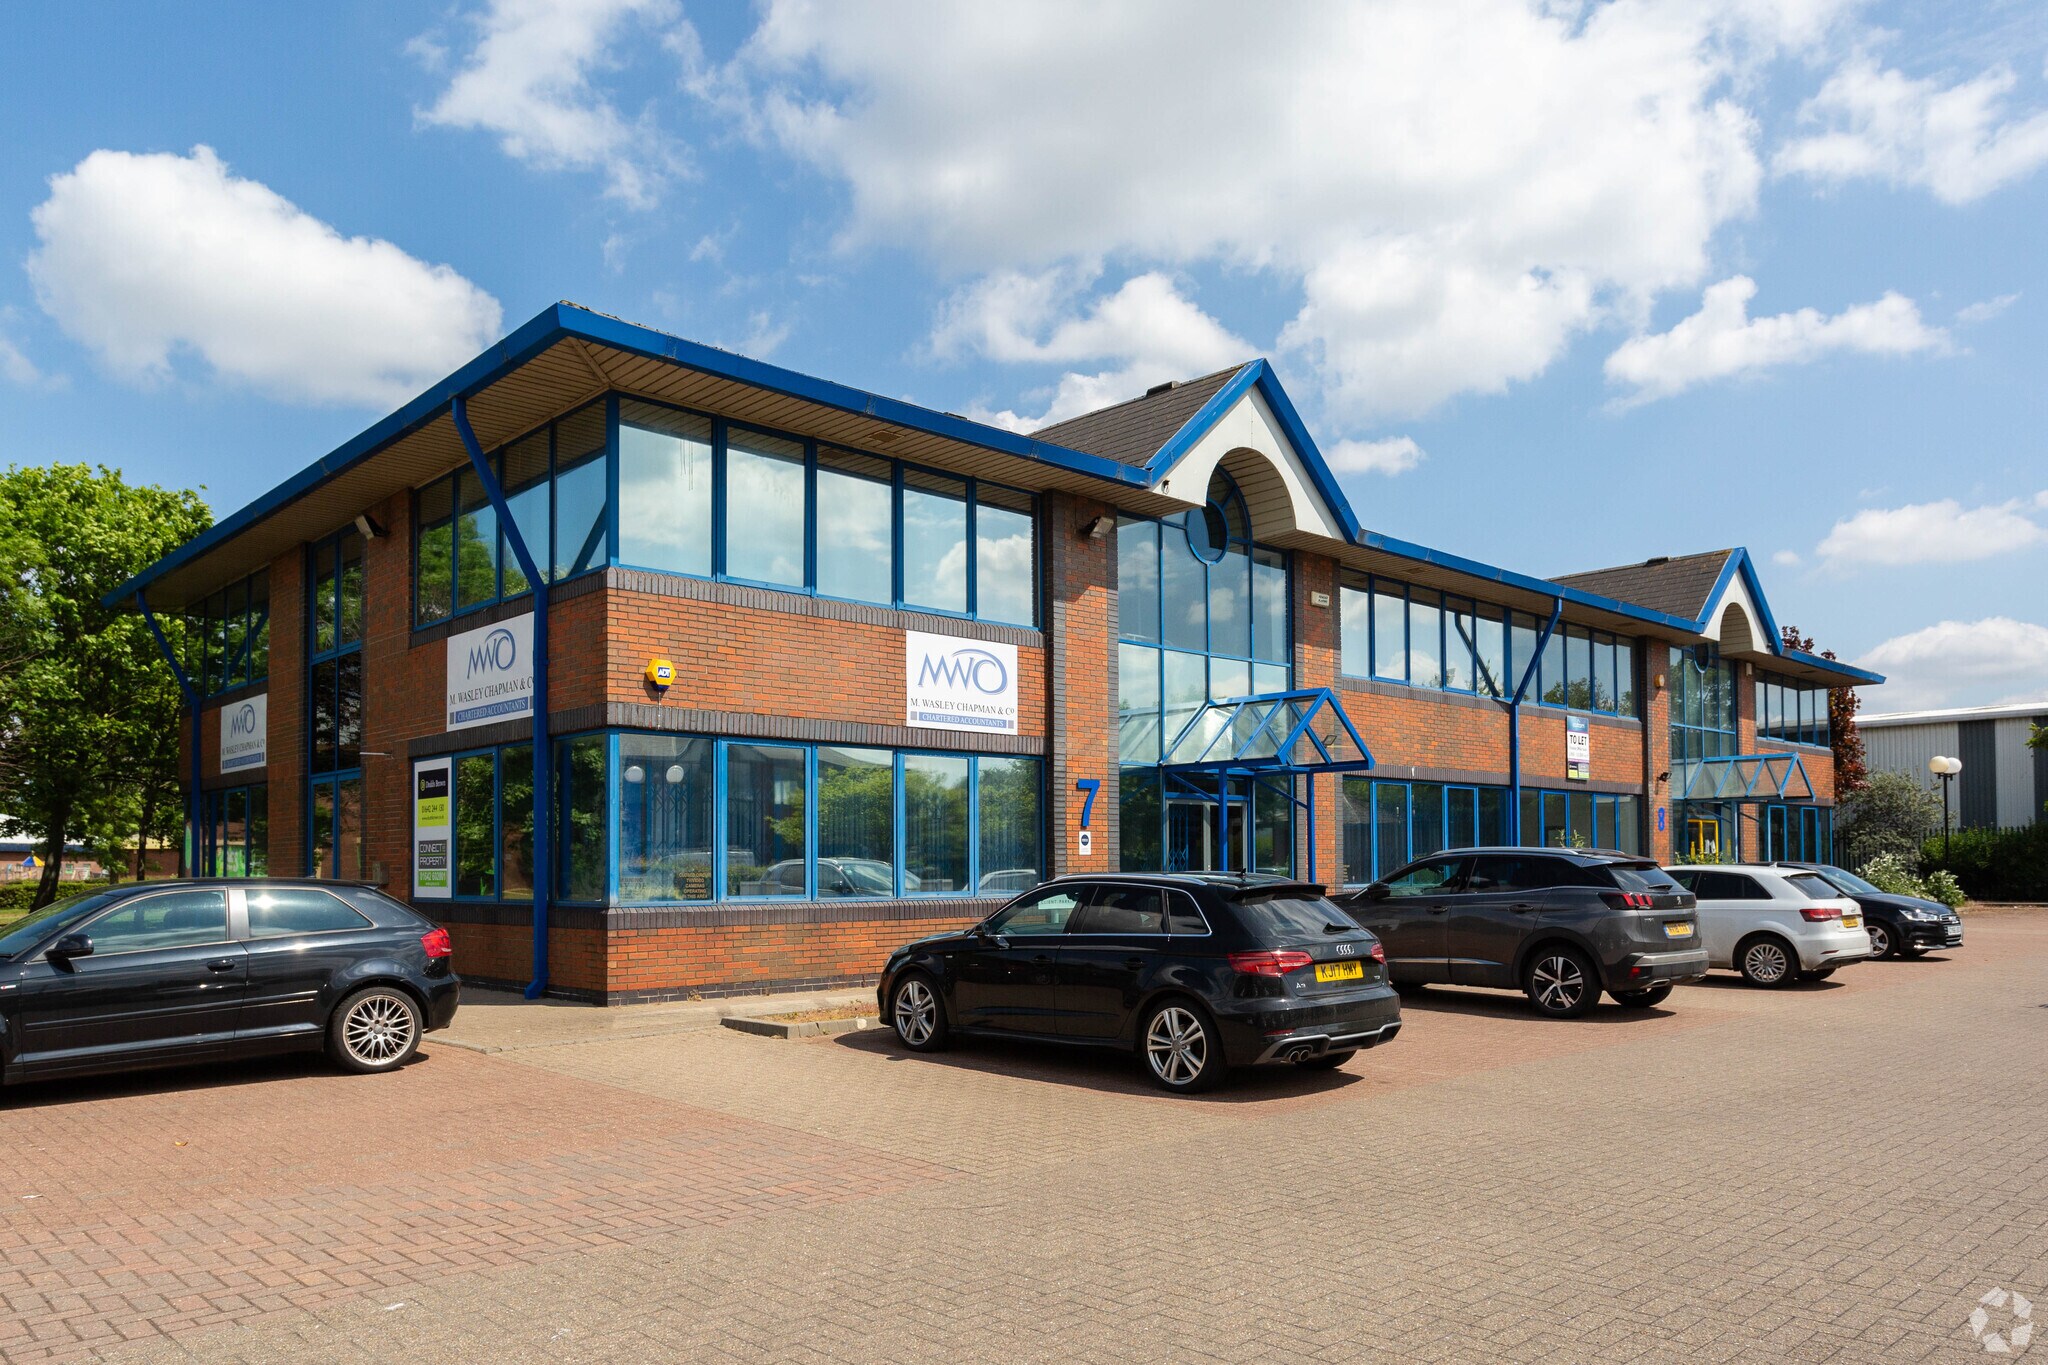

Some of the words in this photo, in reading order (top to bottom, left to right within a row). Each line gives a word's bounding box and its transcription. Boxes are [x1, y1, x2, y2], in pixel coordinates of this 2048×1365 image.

[658, 668, 670, 676] ADT
[458, 687, 483, 704] WASLEY
[484, 678, 519, 698] CHAPMAN
[520, 678, 526, 690] &
[526, 676, 533, 689] C
[458, 707, 487, 721] CHARTERED
[487, 700, 526, 716] ACCOUNTANTS
[910, 698, 920, 707] M.
[922, 699, 956, 710] WASLEY
[956, 702, 996, 714] CHAPMAN
[998, 706, 1004, 715] &
[922, 714, 960, 723] CHARTERED
[960, 718, 1004, 727] ACCOUNTANTS
[1570, 734, 1577, 744] TO
[1578, 736, 1587, 746] LET
[1076, 779, 1100, 827] 7
[1658, 807, 1665, 831] 8
[420, 844, 442, 853] CONNECT
[420, 856, 446, 866] PROPERTY
[1321, 964, 1340, 979] KJ17
[1342, 962, 1358, 976] HMY
